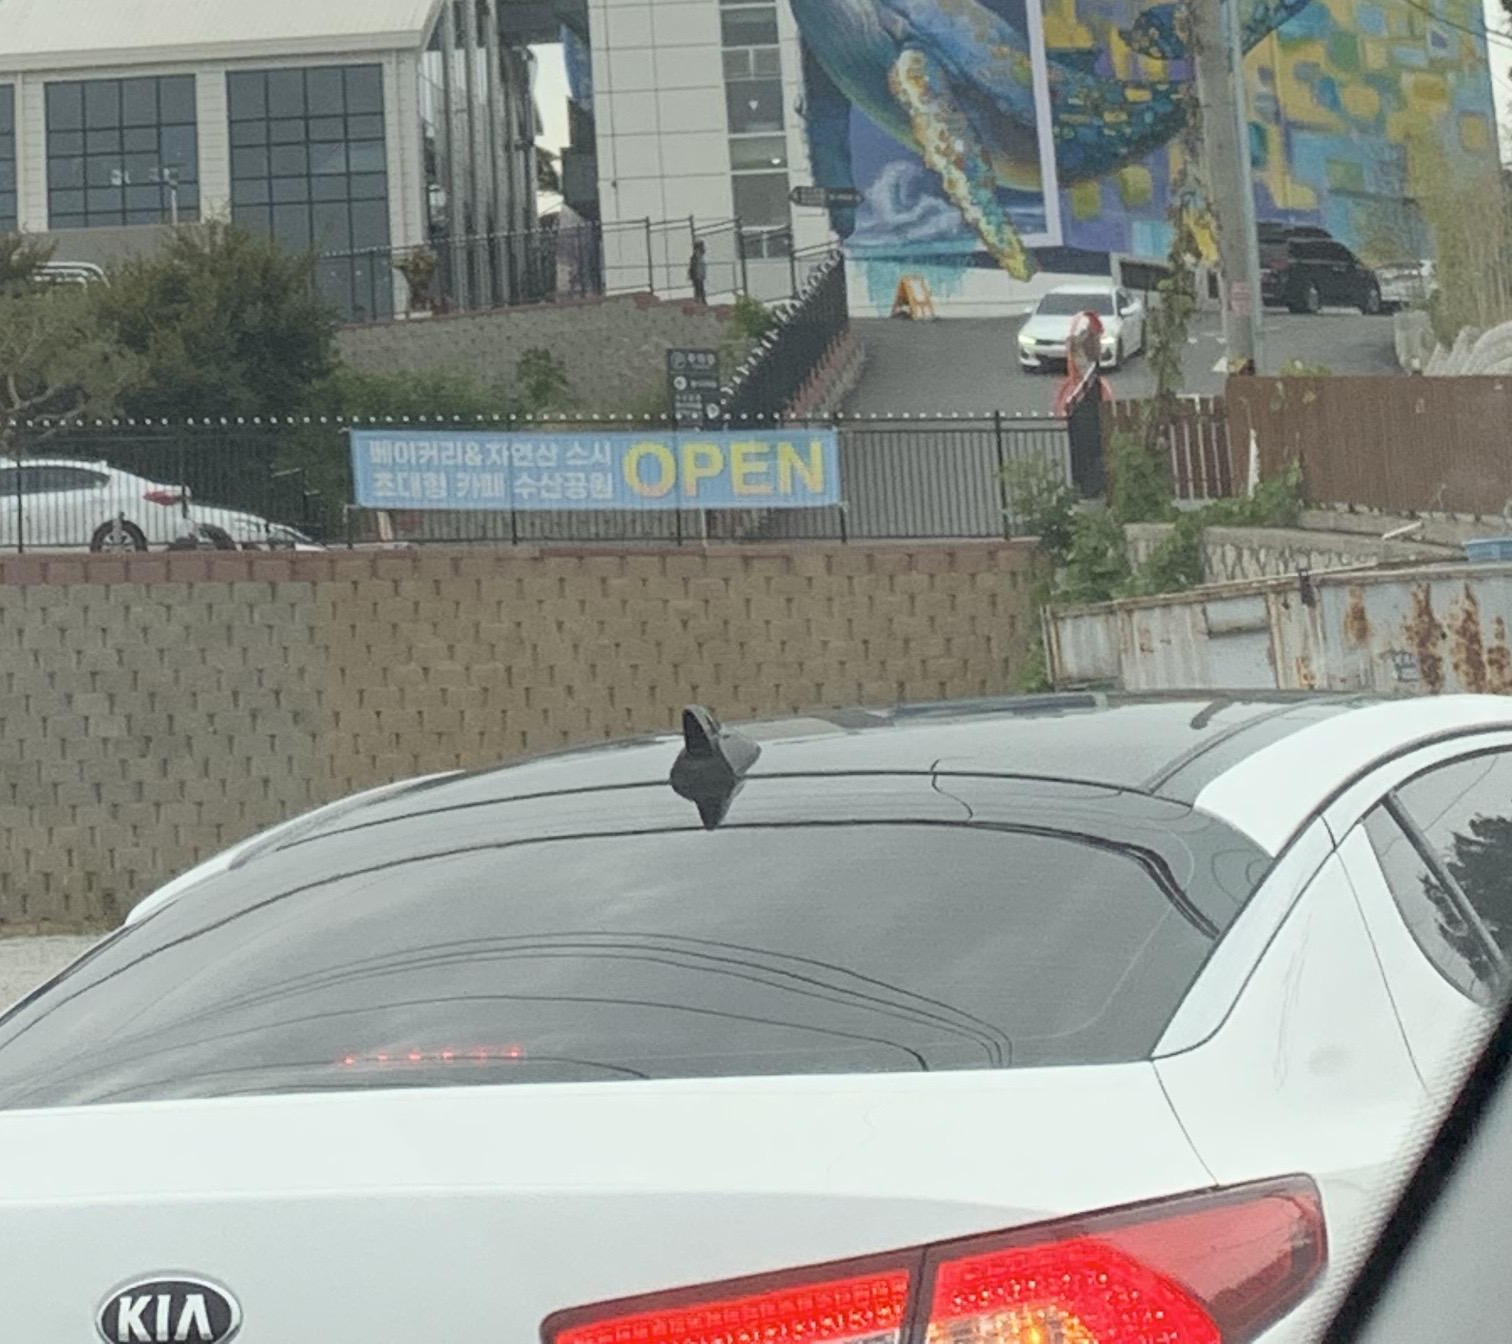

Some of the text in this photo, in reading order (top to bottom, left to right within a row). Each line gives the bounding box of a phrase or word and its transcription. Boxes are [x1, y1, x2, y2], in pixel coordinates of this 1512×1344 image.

[565, 440, 612, 467] 스시
[622, 439, 826, 498] OPEN
[513, 470, 615, 500] 수산공원
[118, 1293, 214, 1343] KIA
